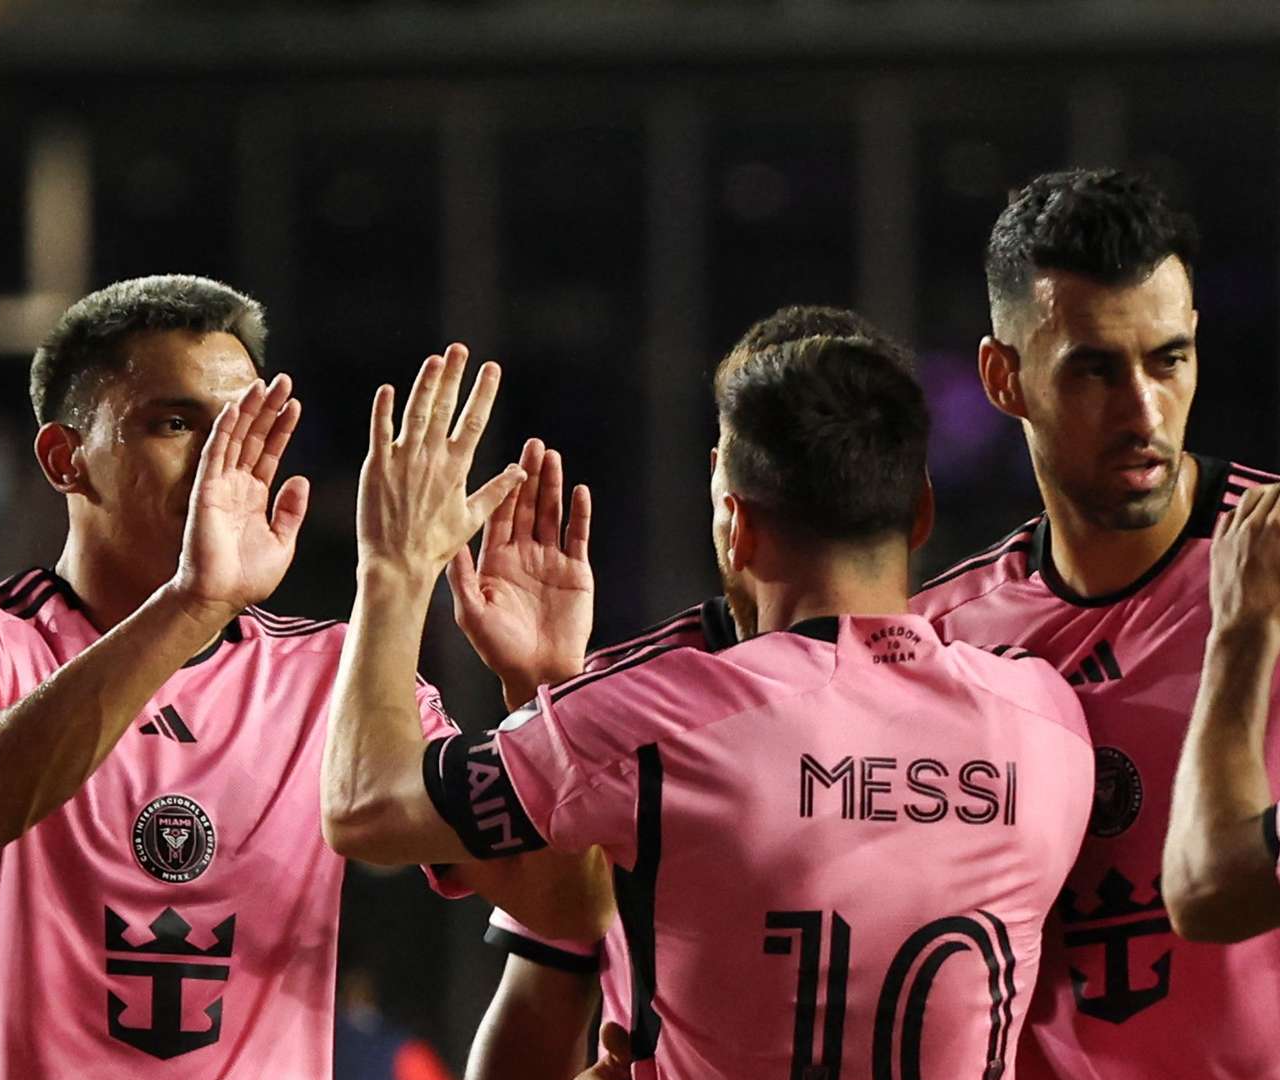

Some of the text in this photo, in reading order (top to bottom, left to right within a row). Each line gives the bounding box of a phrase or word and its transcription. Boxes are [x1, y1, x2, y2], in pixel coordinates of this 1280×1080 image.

[799, 754, 1016, 826] MESSI
[135, 797, 201, 834] INTERNACIONAL
[159, 818, 192, 827] MIAMI
[200, 815, 210, 827] DE
[135, 838, 148, 862] CLUB
[161, 871, 190, 881] MMXX
